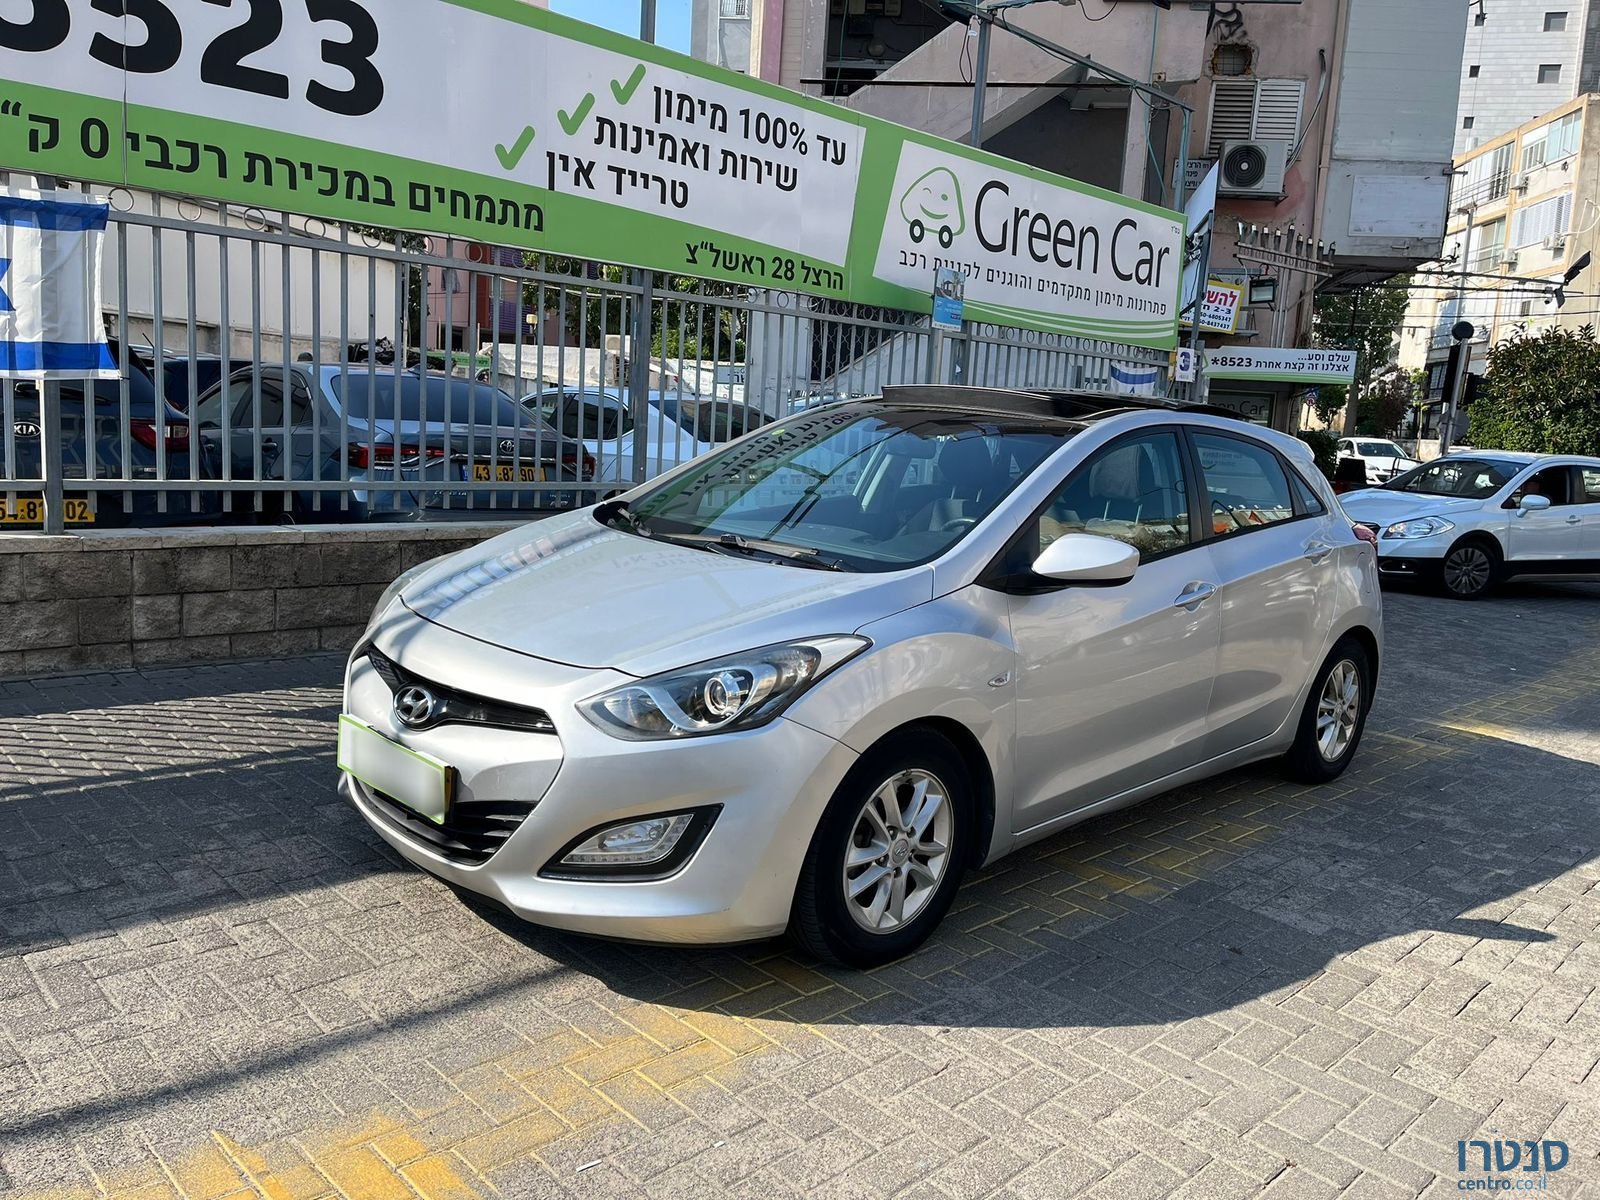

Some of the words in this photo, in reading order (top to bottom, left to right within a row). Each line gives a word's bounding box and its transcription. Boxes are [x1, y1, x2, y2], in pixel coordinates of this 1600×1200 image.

[653, 85, 729, 133] מימון
[80, 117, 109, 159] 0
[594, 115, 711, 171] ואמינות
[738, 107, 808, 156] 100%
[126, 131, 228, 178] רכבי
[817, 133, 847, 166] עד
[243, 151, 396, 207] במכירת
[545, 150, 596, 191] אין
[718, 147, 798, 192] שירות
[607, 164, 689, 209] טרייד
[408, 182, 545, 232] מתמחים
[973, 179, 1099, 274] Green
[1110, 217, 1170, 288] Car
[771, 256, 796, 282] 28
[800, 259, 844, 290] הרצל
[899, 250, 927, 270] רכב
[986, 268, 1032, 289] והוגנים
[1037, 279, 1091, 301] מתקדמים
[1095, 289, 1124, 308] מימון
[1127, 295, 1167, 316] פתרונות
[1254, 360, 1281, 369] אחרת
[1284, 361, 1304, 371] קצת
[1307, 362, 1319, 370] זה
[1321, 362, 1350, 372] אצלנו
[1328, 353, 1350, 362] שלם
[13, 425, 37, 435] KIA
